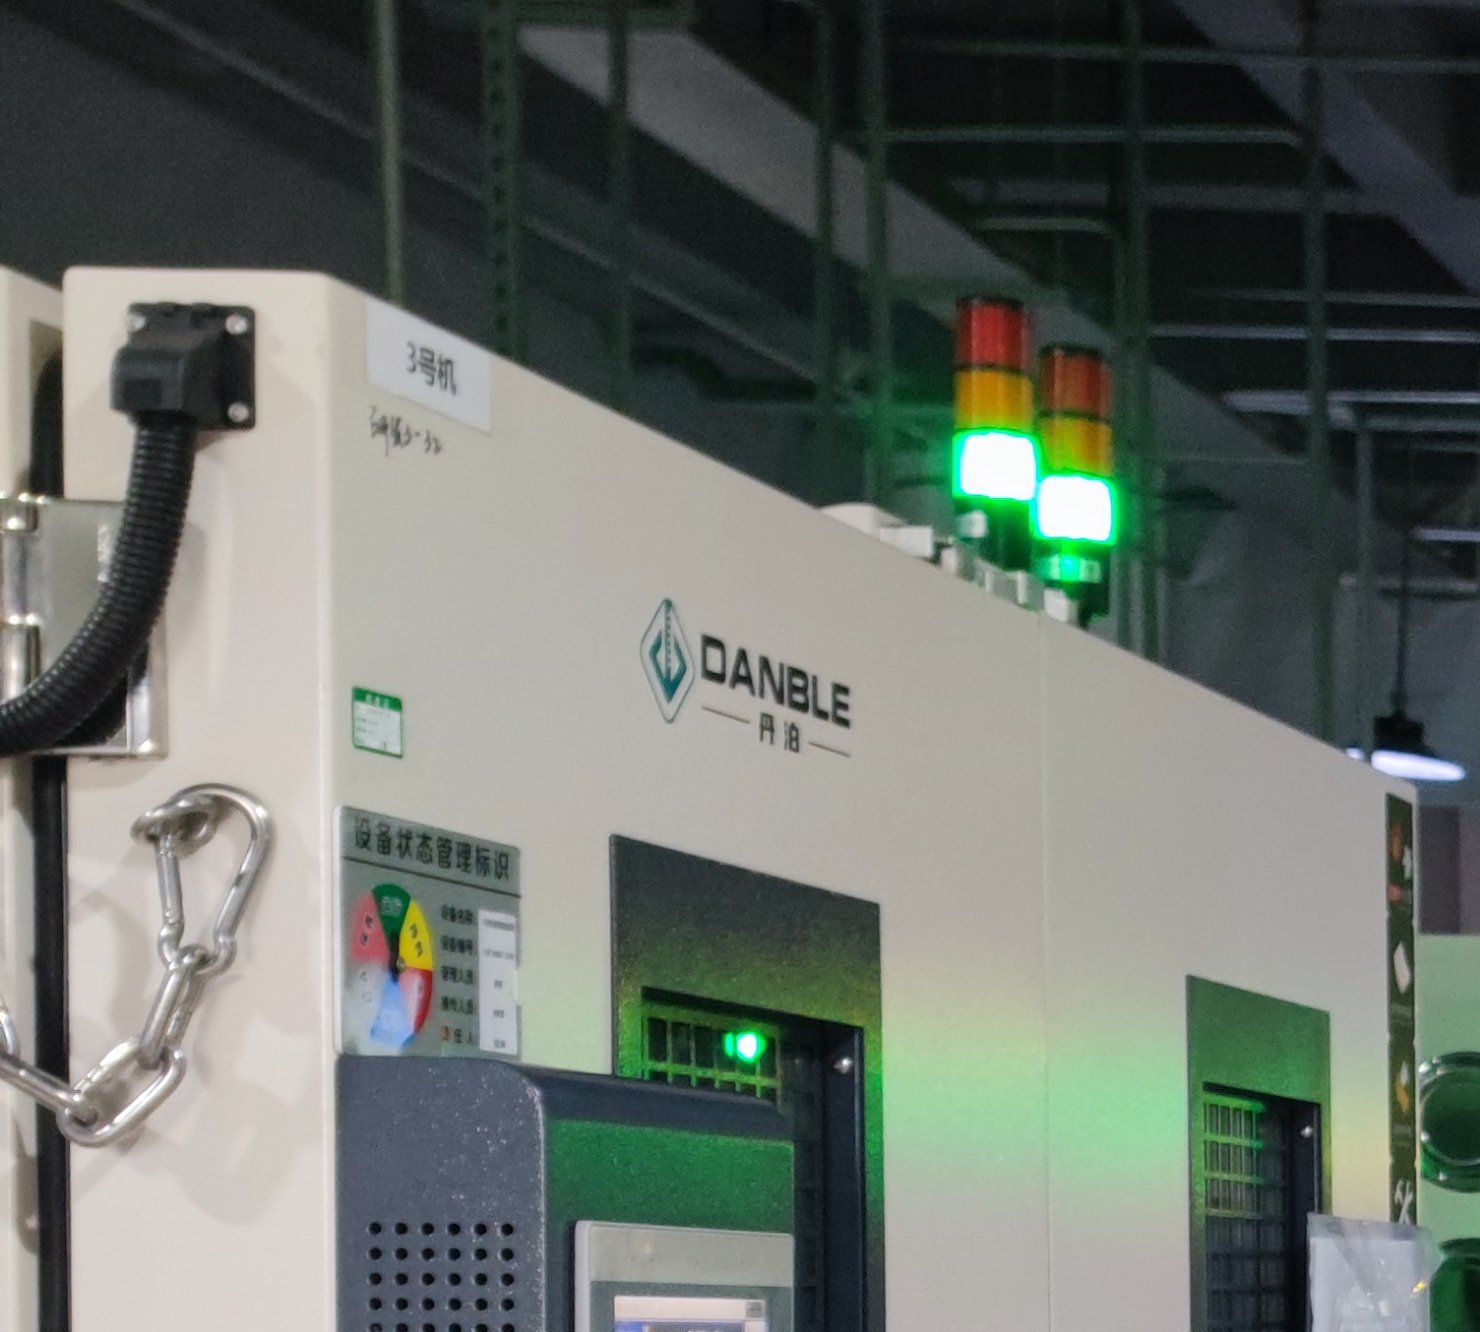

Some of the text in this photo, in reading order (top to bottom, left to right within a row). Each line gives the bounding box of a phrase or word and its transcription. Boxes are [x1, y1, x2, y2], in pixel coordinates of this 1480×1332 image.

[406, 340, 457, 396] 3号机
[701, 633, 851, 730] DANBLE
[759, 711, 801, 754] 丹泊
[354, 815, 511, 882] 设备状态管理标识
